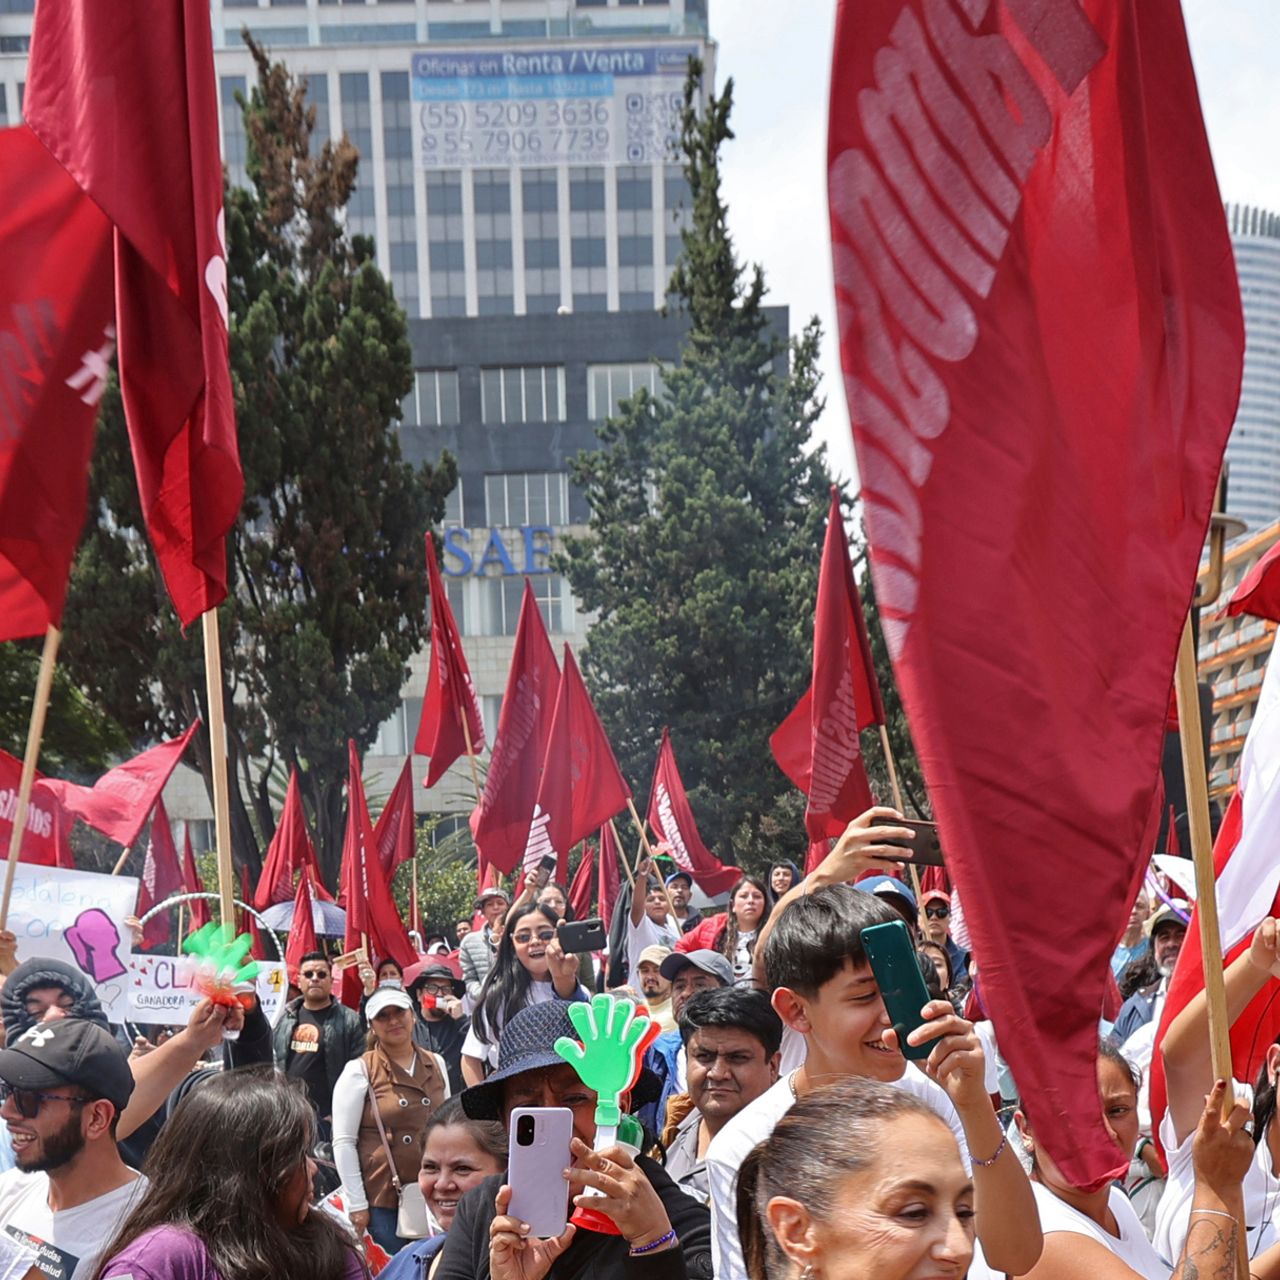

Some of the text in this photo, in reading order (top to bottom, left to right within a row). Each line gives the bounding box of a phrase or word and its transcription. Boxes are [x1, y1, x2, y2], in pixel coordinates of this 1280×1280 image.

[420, 58, 476, 76] Oficinas
[479, 60, 499, 74] en
[503, 53, 562, 75] Renta
[582, 51, 645, 72] Venta
[420, 101, 610, 131] (55) 5209 3636
[443, 128, 610, 152] 55 7906 7739
[39, 1245, 63, 1263] dudas
[39, 1261, 63, 1279] salud
